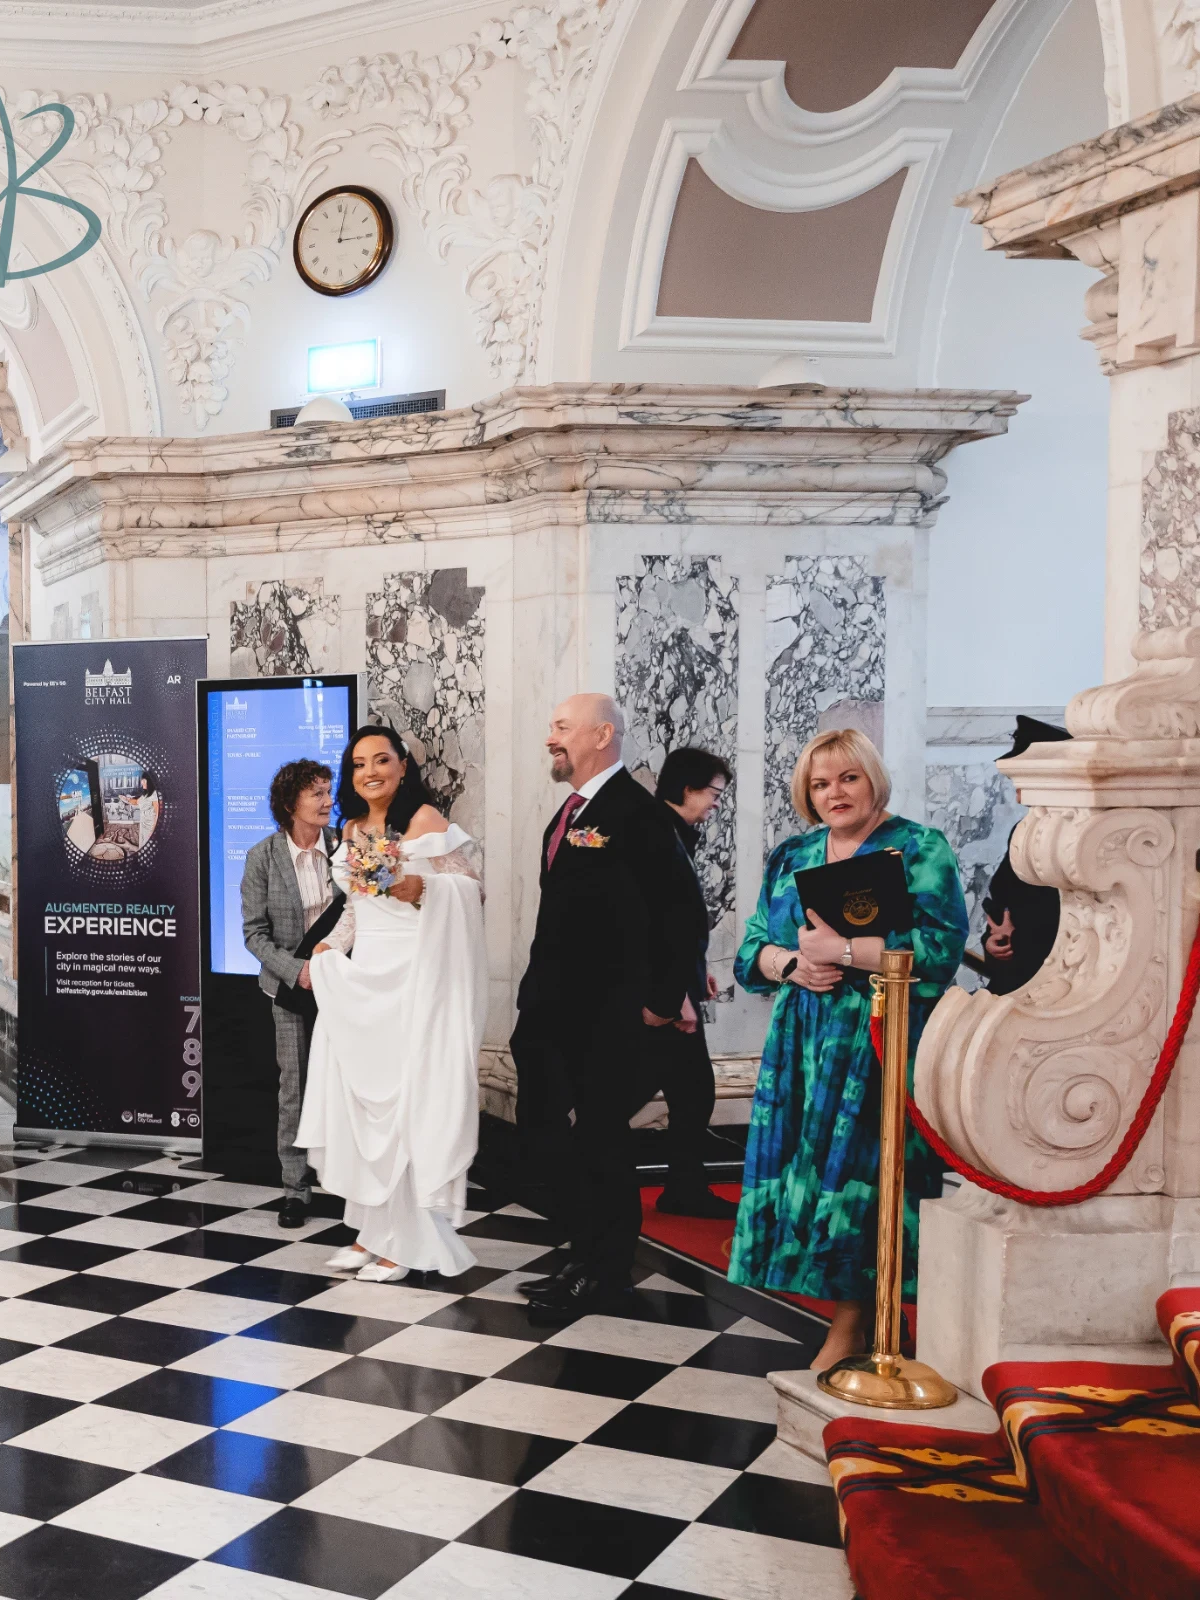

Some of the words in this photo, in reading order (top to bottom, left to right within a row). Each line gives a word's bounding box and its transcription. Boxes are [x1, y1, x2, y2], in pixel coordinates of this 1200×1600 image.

[166, 675, 181, 684] AR
[85, 687, 132, 698] BELFAST
[84, 697, 105, 705] CITY
[109, 697, 132, 705] HALL
[45, 902, 123, 914] AUGMENTED
[126, 904, 175, 916] REALITY
[44, 916, 177, 937] EXPERIENCE
[56, 951, 88, 962] Explore
[90, 953, 104, 961] the
[106, 953, 135, 962] stories
[137, 954, 146, 962] of
[56, 962, 71, 972] city
[73, 963, 80, 971] in
[83, 963, 116, 973] magical
[118, 965, 136, 973] new
[138, 966, 162, 975] ways.
[71, 979, 102, 987] reception
[113, 980, 135, 988] tickets
[56, 987, 148, 997] belfastcity.gov.uk/exhibition
[183, 1005, 200, 1033] 7
[182, 1038, 201, 1066] 8
[181, 1070, 201, 1098] 9
